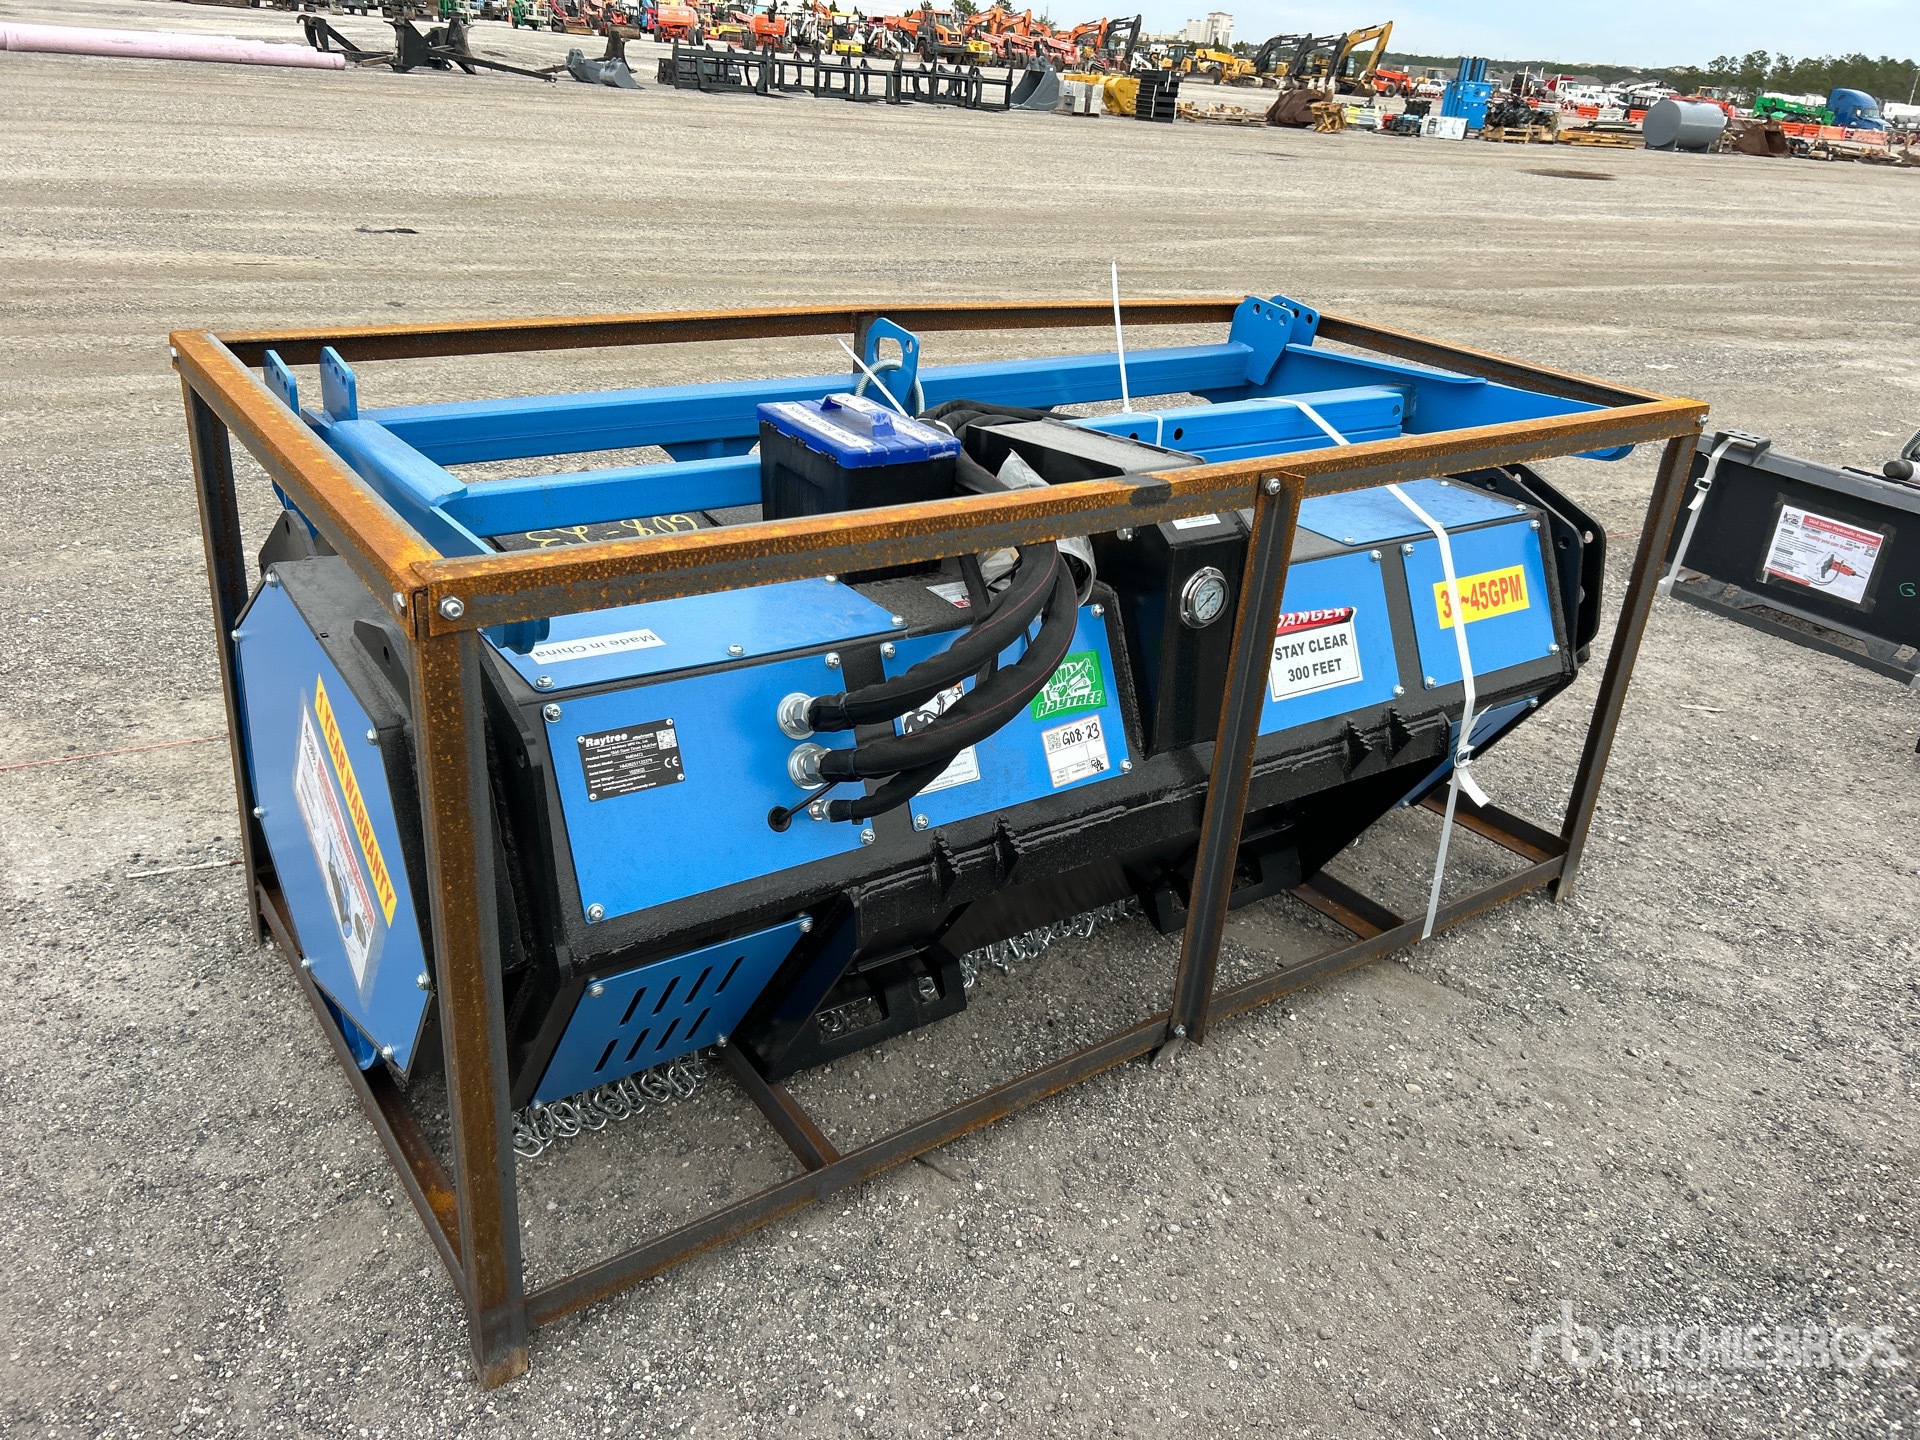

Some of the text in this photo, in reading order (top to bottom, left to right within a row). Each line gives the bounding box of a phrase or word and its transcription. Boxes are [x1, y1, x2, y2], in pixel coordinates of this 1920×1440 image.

[1805, 532, 1820, 542] Quality
[1833, 525, 1856, 536] Hydraulic
[1441, 574, 1523, 618] 3~45GPM
[608, 634, 656, 646] Made
[1275, 633, 1348, 660] STAY CLEAR
[535, 645, 587, 657] China
[1288, 658, 1342, 682] 300 FEET
[1036, 690, 1102, 718] RAYTREE
[586, 733, 628, 747] Raytree
[325, 704, 346, 780] YEAR
[345, 767, 393, 908] WARRANTY
